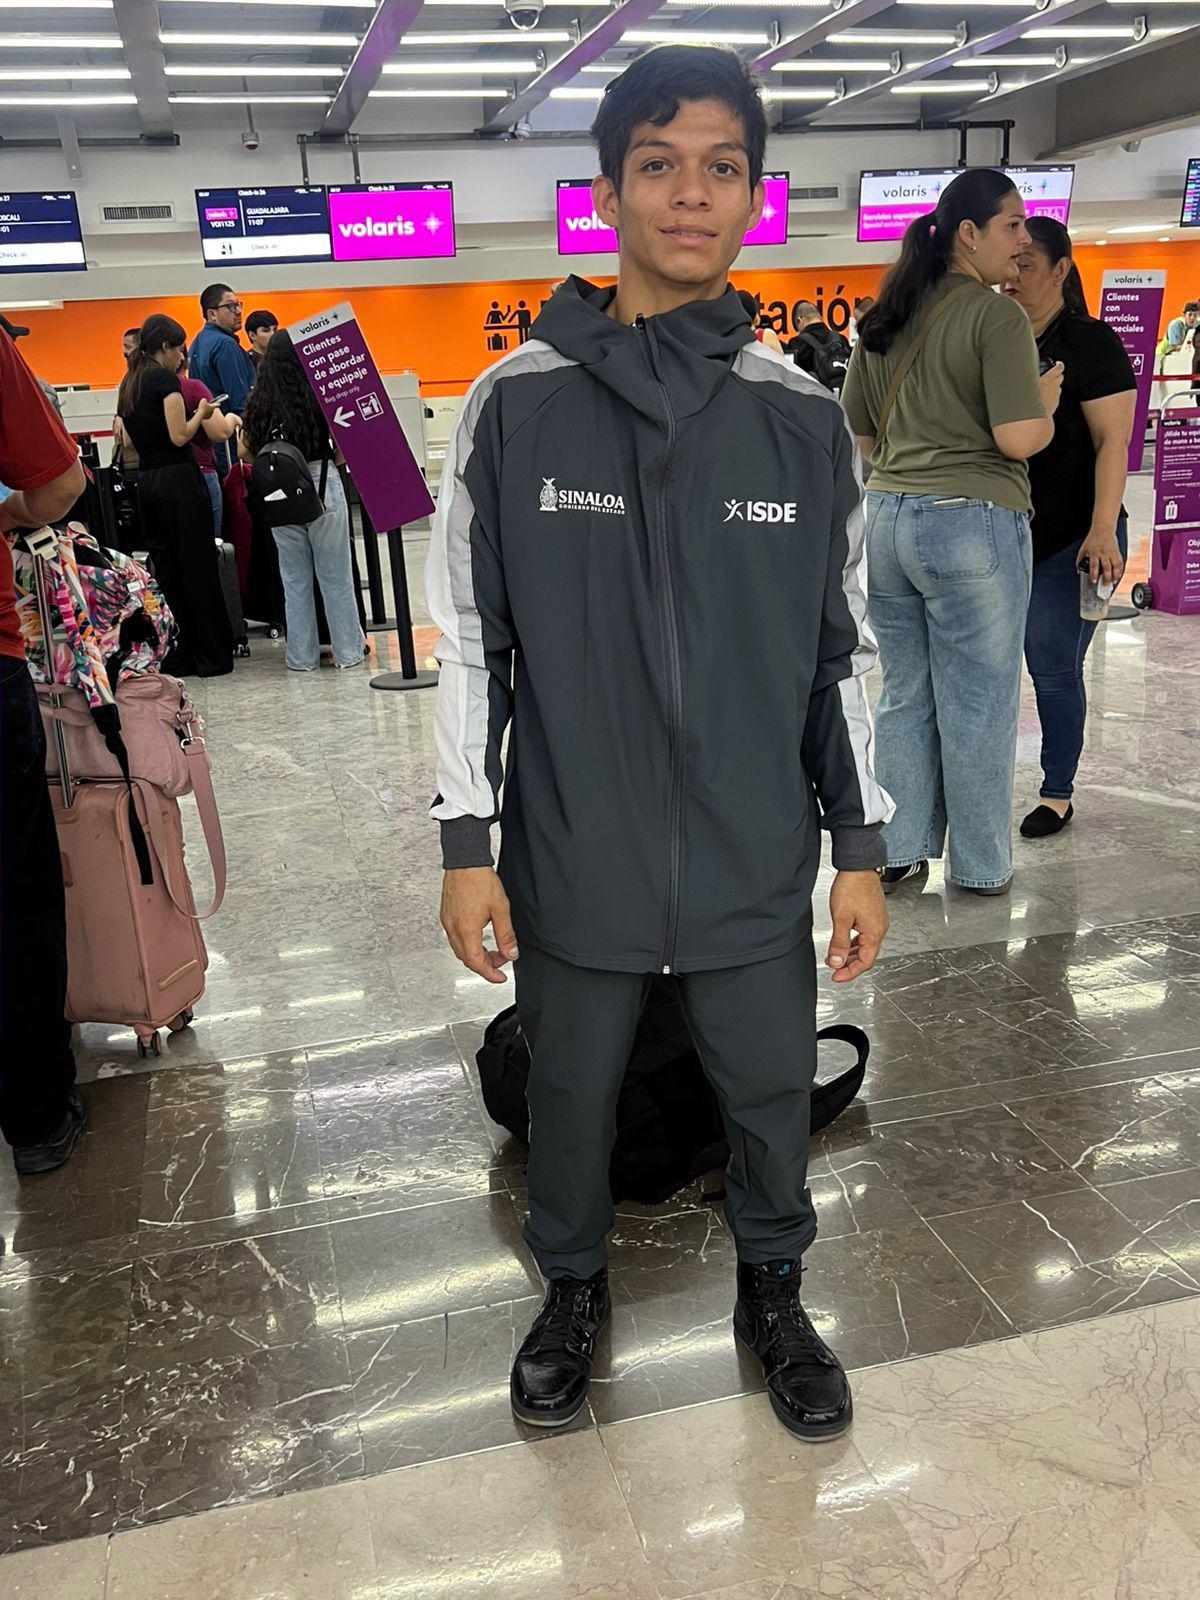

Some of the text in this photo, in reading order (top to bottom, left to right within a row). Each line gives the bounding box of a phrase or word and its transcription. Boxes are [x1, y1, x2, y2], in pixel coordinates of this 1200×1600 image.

[882, 184, 927, 198] volaris
[246, 206, 290, 215] GUADALAJARA
[338, 215, 416, 238] volaris
[1114, 275, 1144, 284] volaris
[1106, 292, 1140, 302] Clientes
[1105, 304, 1121, 312] con
[300, 317, 330, 335] volaris
[1104, 315, 1140, 323] servicios
[302, 334, 342, 356] Clientes
[308, 345, 350, 368] con pase
[314, 353, 366, 381] de abordar
[319, 367, 368, 396] y equipaje
[335, 391, 350, 401] drop
[558, 489, 626, 510] SINALOA
[558, 503, 626, 516] GOBIERNO DEL ESTADO
[746, 500, 797, 523] ISDE
